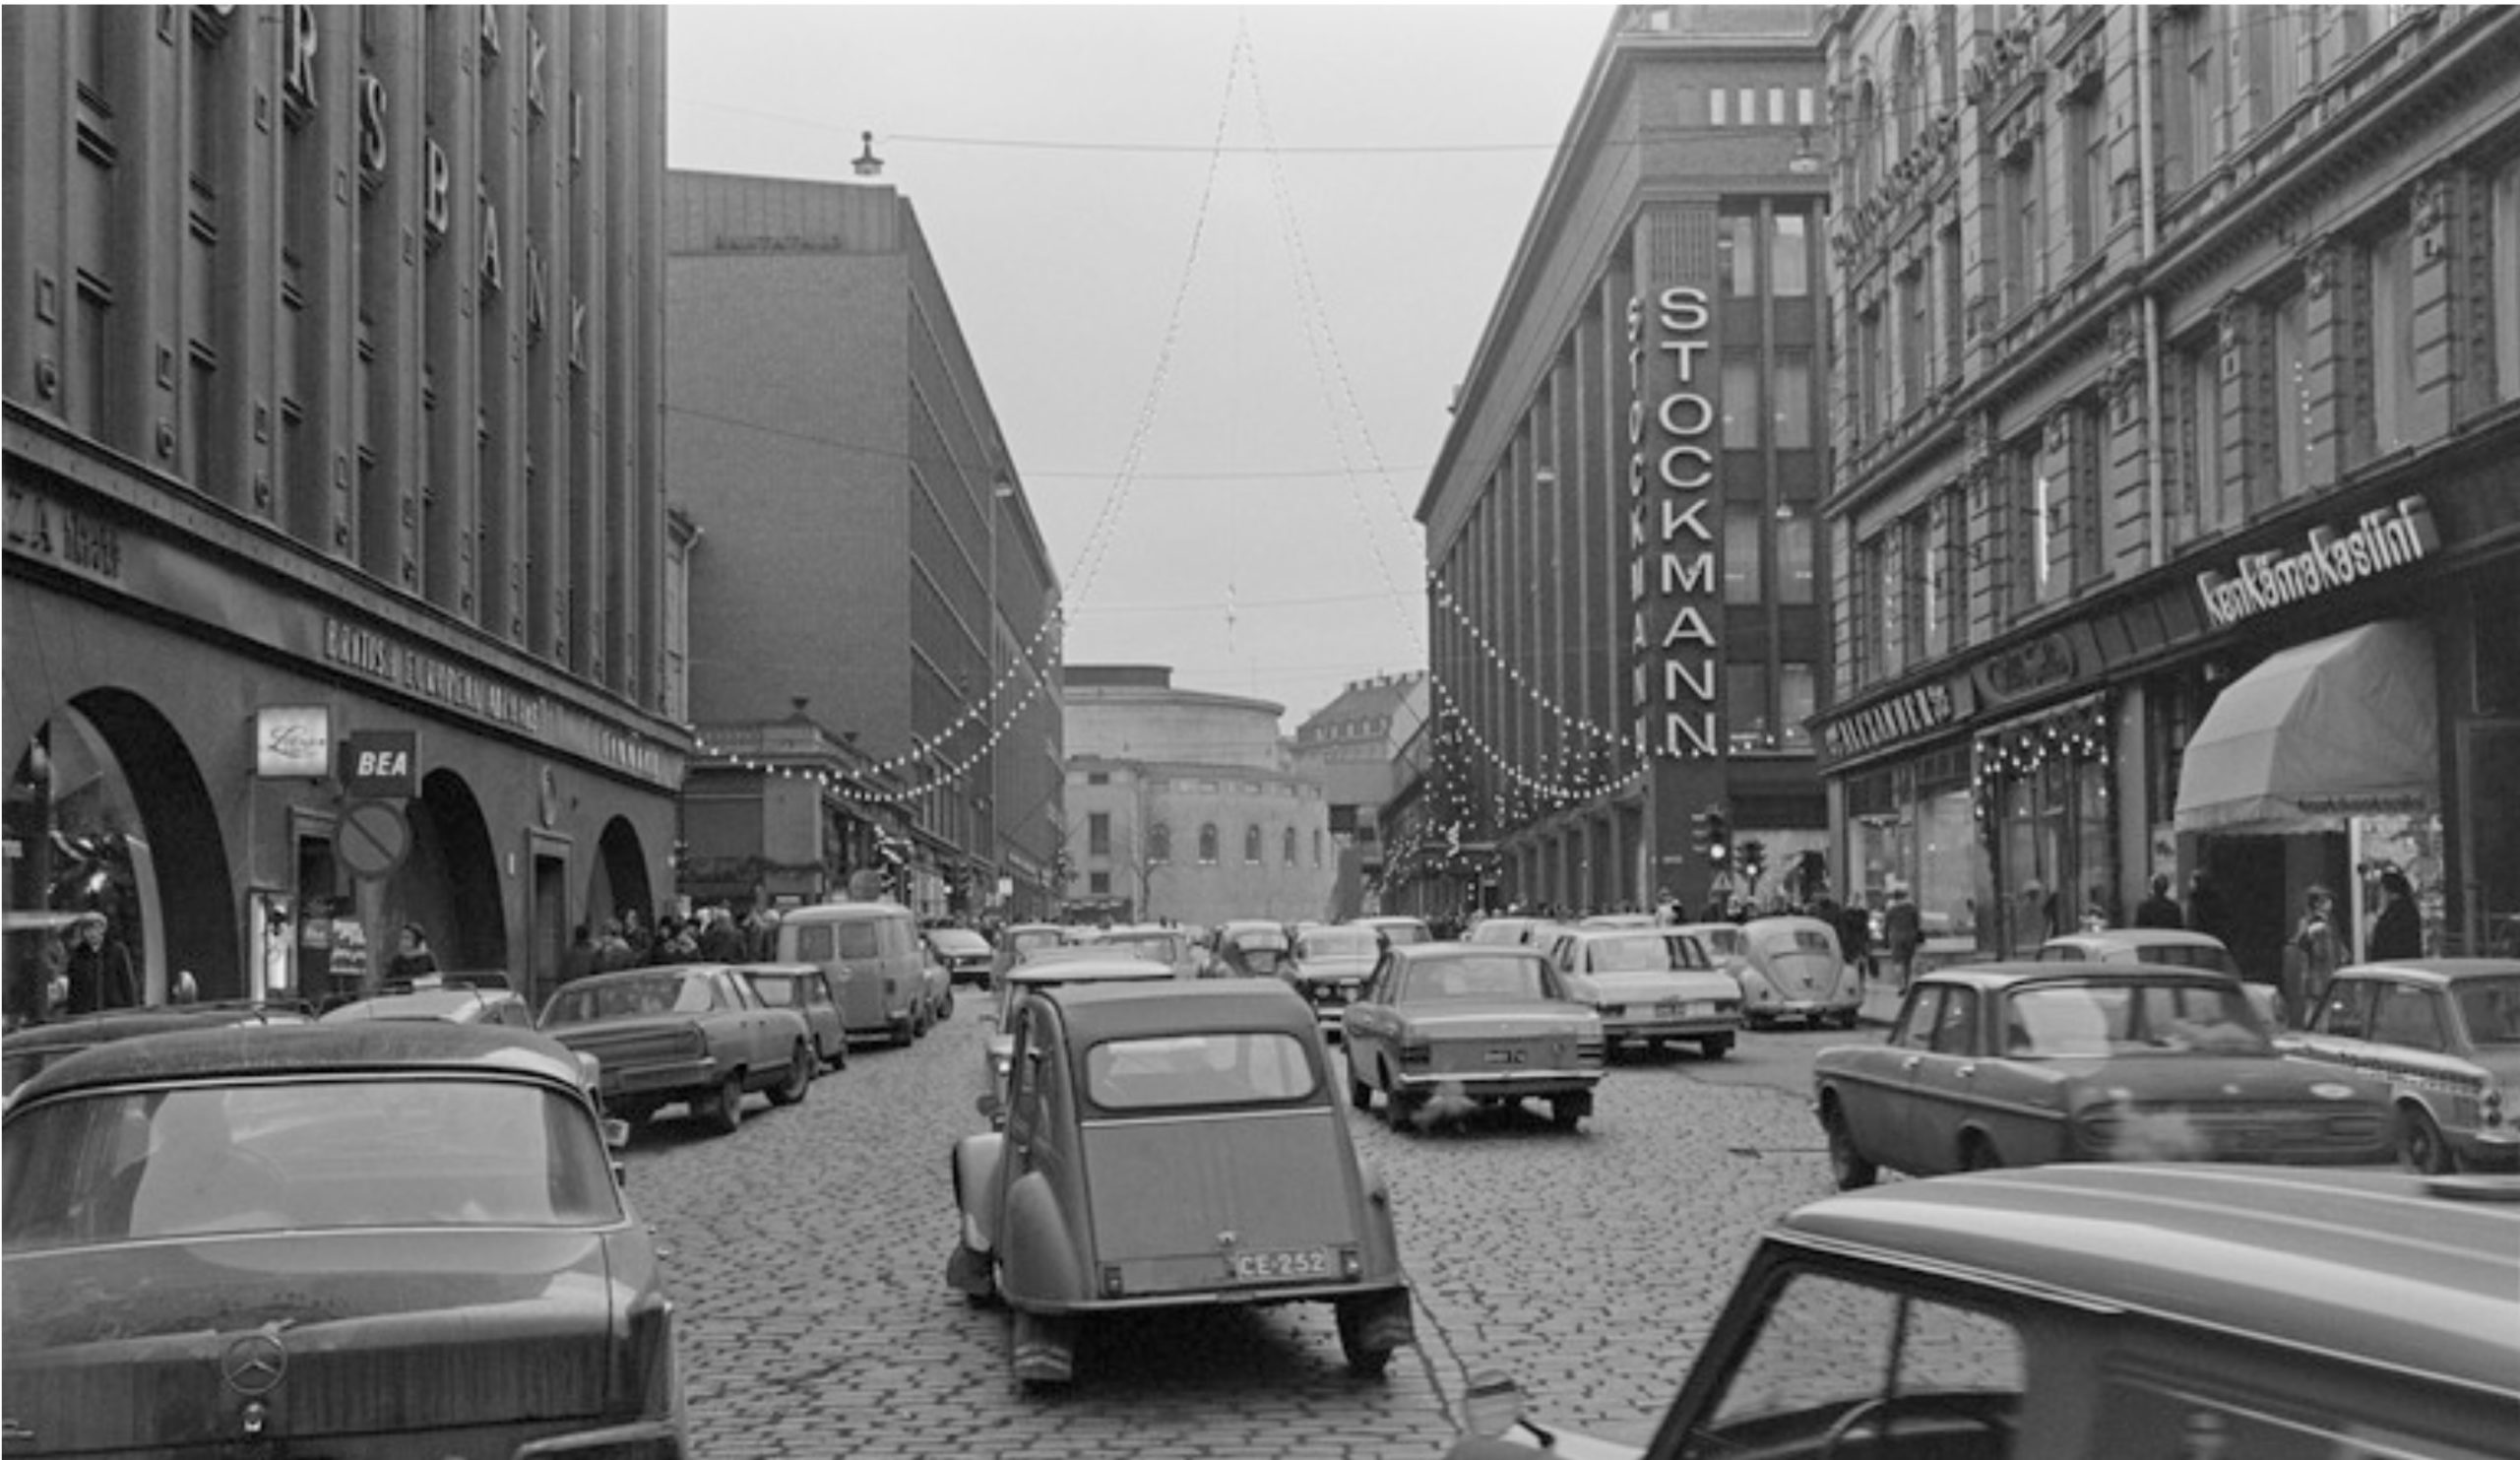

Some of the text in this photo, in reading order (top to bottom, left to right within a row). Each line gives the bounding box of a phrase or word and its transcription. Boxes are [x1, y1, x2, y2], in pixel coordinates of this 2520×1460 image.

[214, 5, 586, 373] RSBANK
[1626, 296, 1648, 759] STOCKMANN
[1658, 286, 1717, 756] STOCKMANN
[357, 751, 408, 776] BEA
[1239, 1252, 1326, 1274] CE-252
